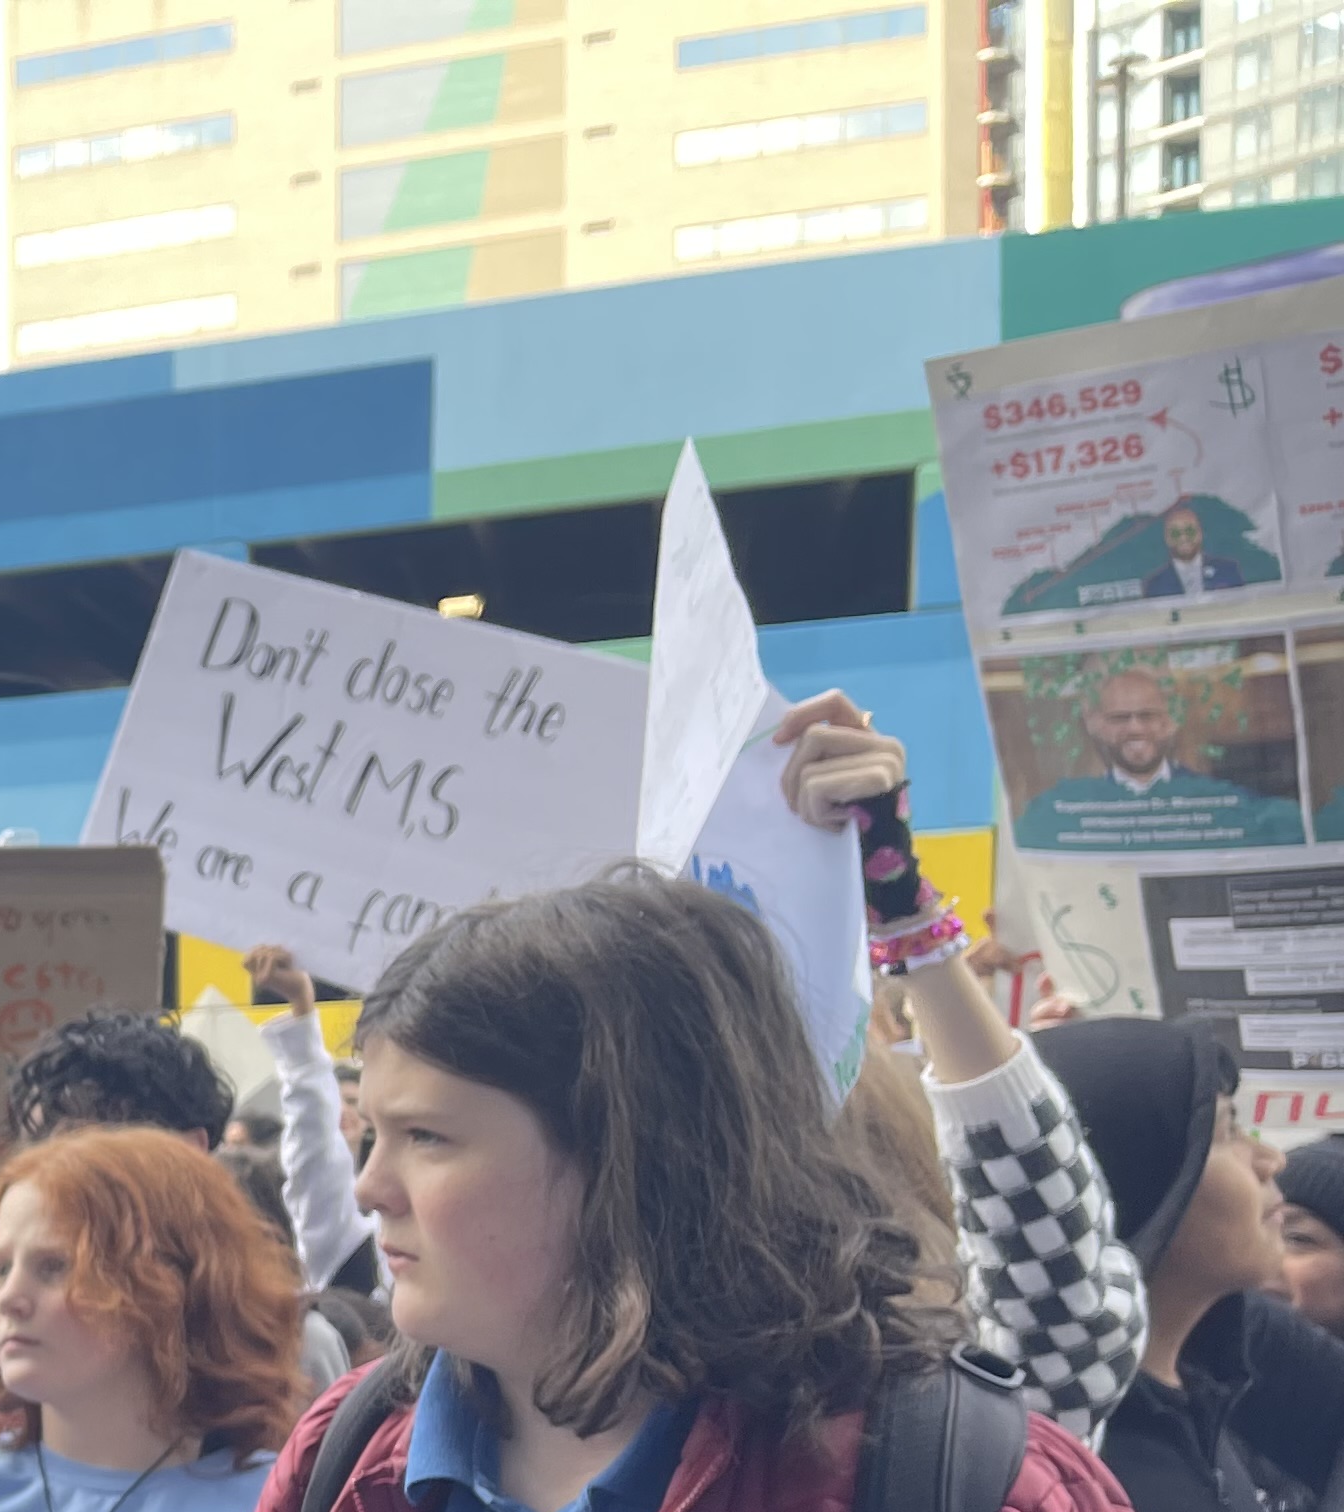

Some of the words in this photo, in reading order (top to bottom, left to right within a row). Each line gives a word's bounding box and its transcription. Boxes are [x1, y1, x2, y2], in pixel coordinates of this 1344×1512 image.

[982, 379, 1144, 431] $346,529
[992, 433, 1146, 480] +$17,326
[201, 597, 329, 688] Don't
[345, 640, 455, 718] close
[482, 667, 566, 743] the
[216, 693, 348, 803] West
[115, 785, 179, 864] We
[195, 844, 254, 891] are
[287, 869, 324, 913] a
